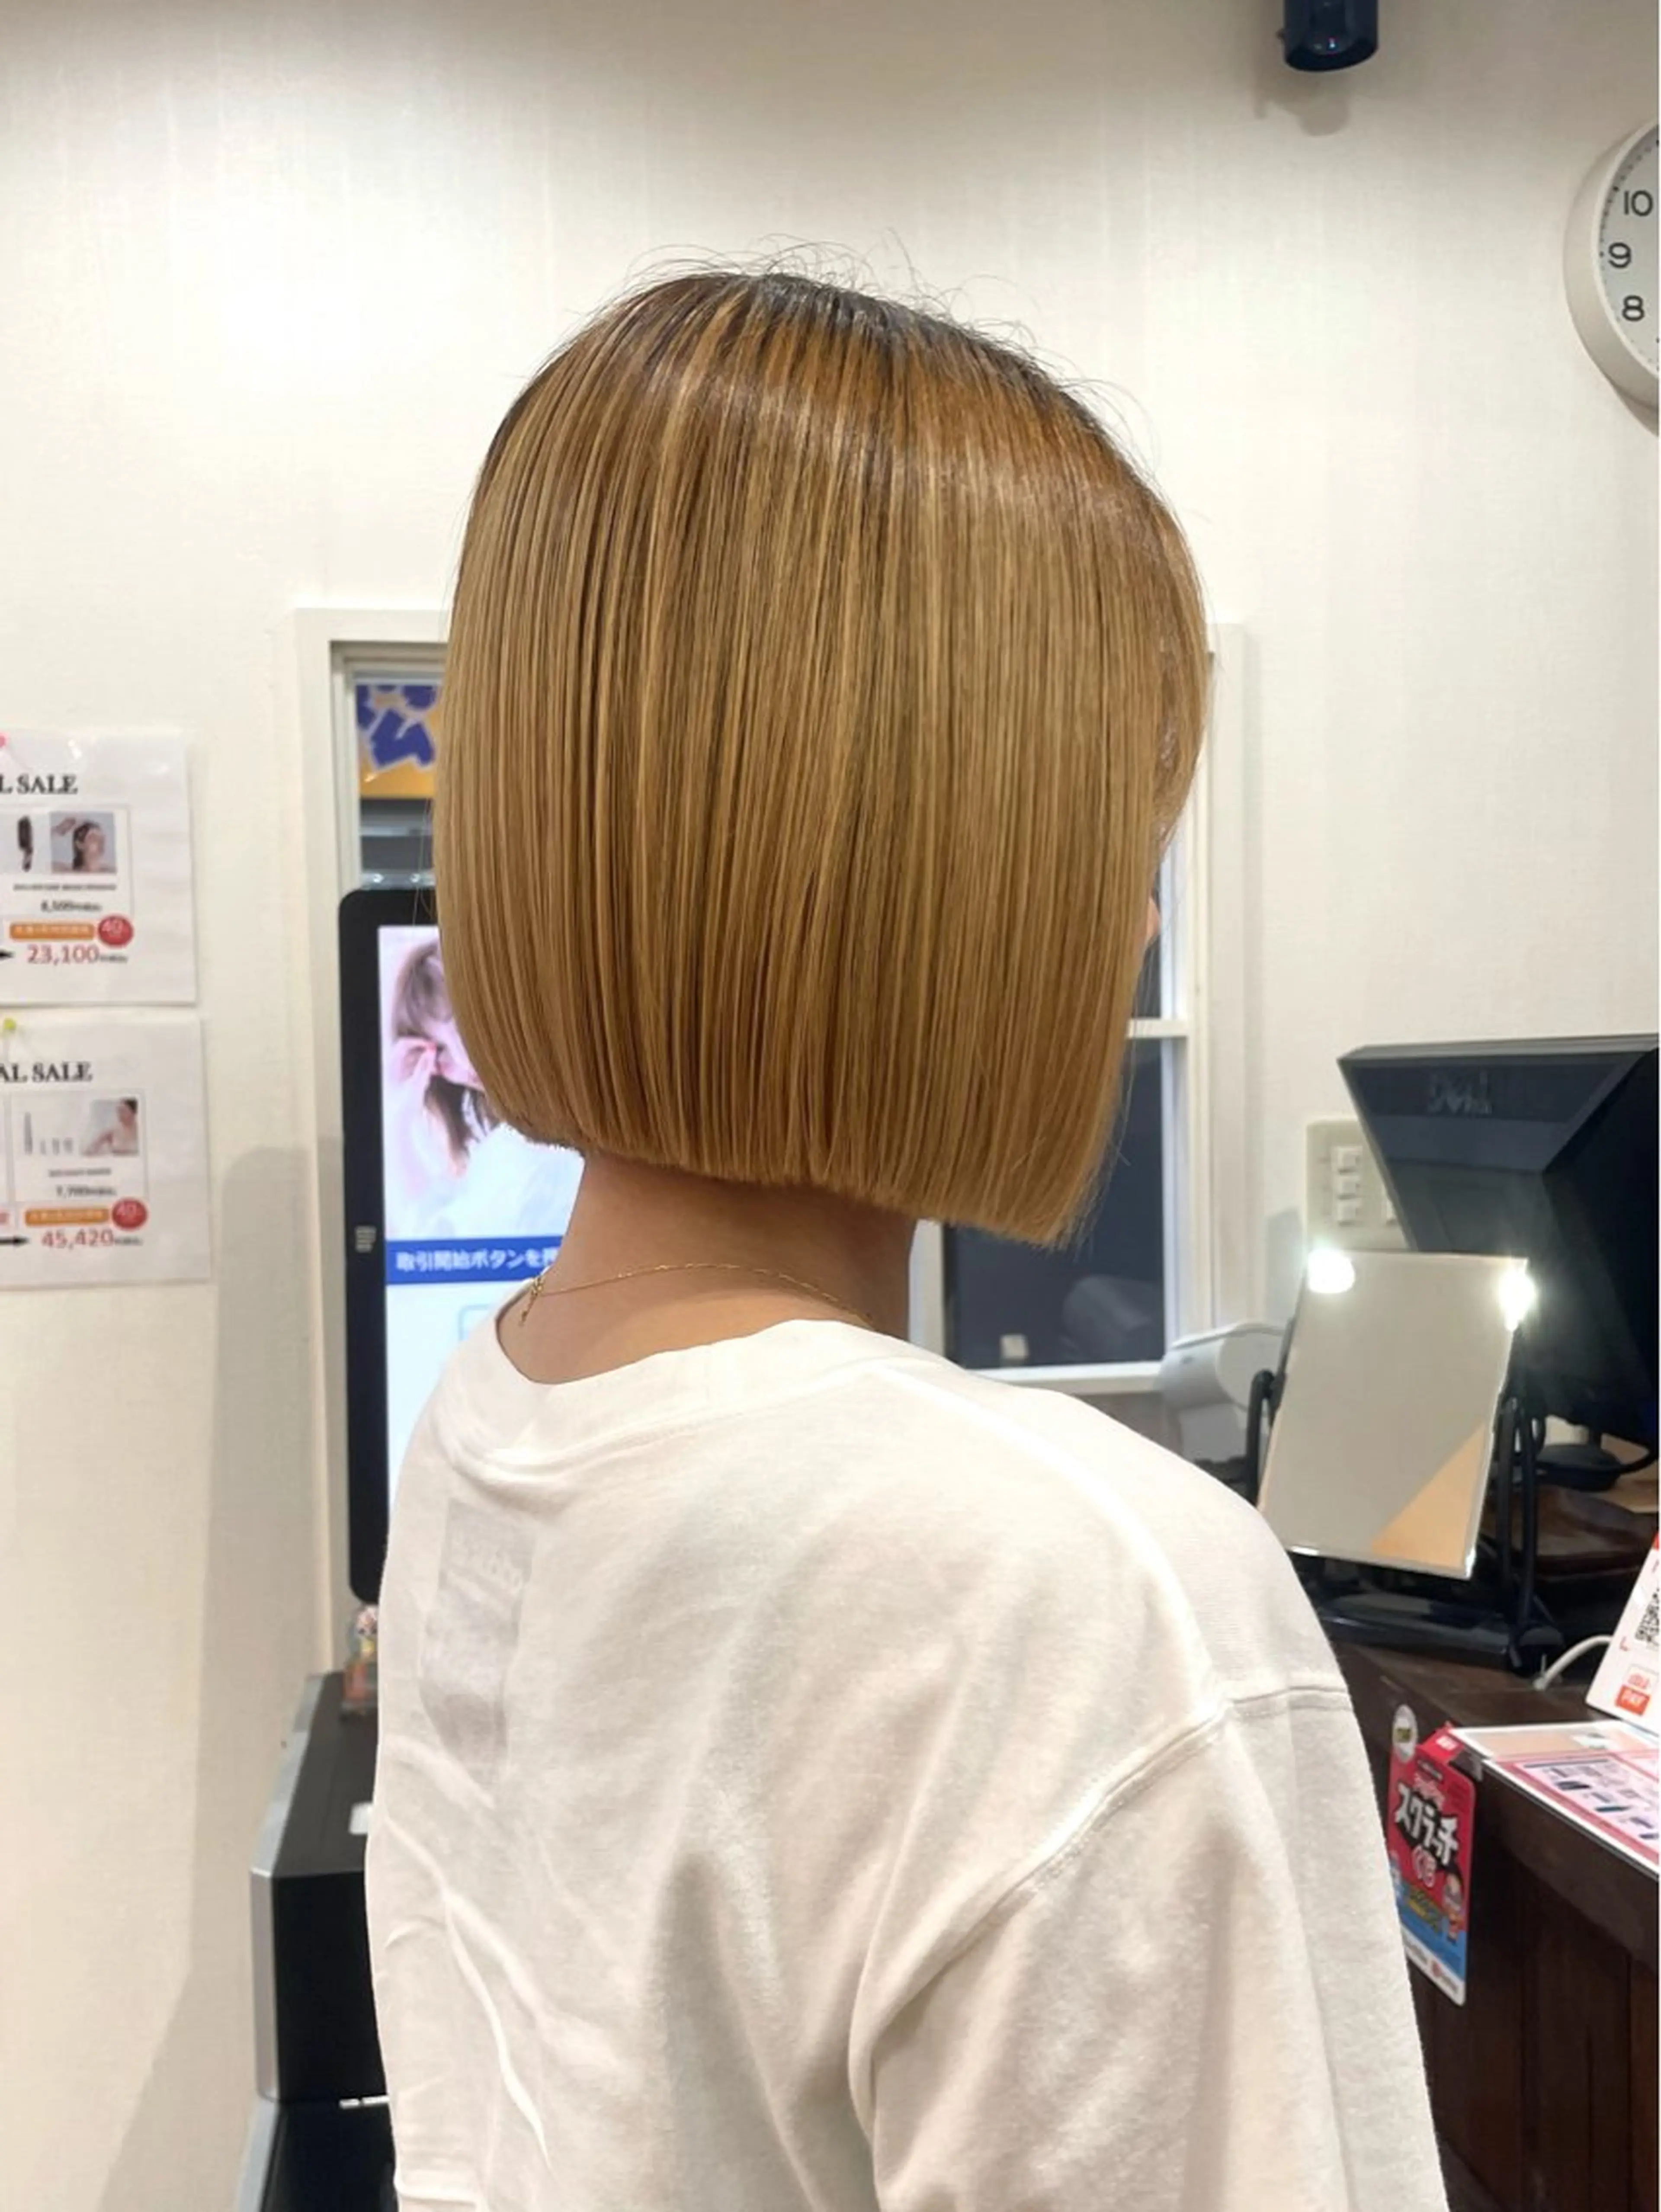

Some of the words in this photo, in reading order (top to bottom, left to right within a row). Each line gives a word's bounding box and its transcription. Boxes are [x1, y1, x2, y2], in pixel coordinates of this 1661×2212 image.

[1624, 189, 1653, 216] 10
[1608, 242, 1631, 268] 9
[1622, 295, 1645, 321] 8
[17, 773, 78, 795] SALE
[27, 944, 99, 965] 23,100
[32, 1061, 93, 1083] SALE
[42, 1230, 114, 1249] 45,420
